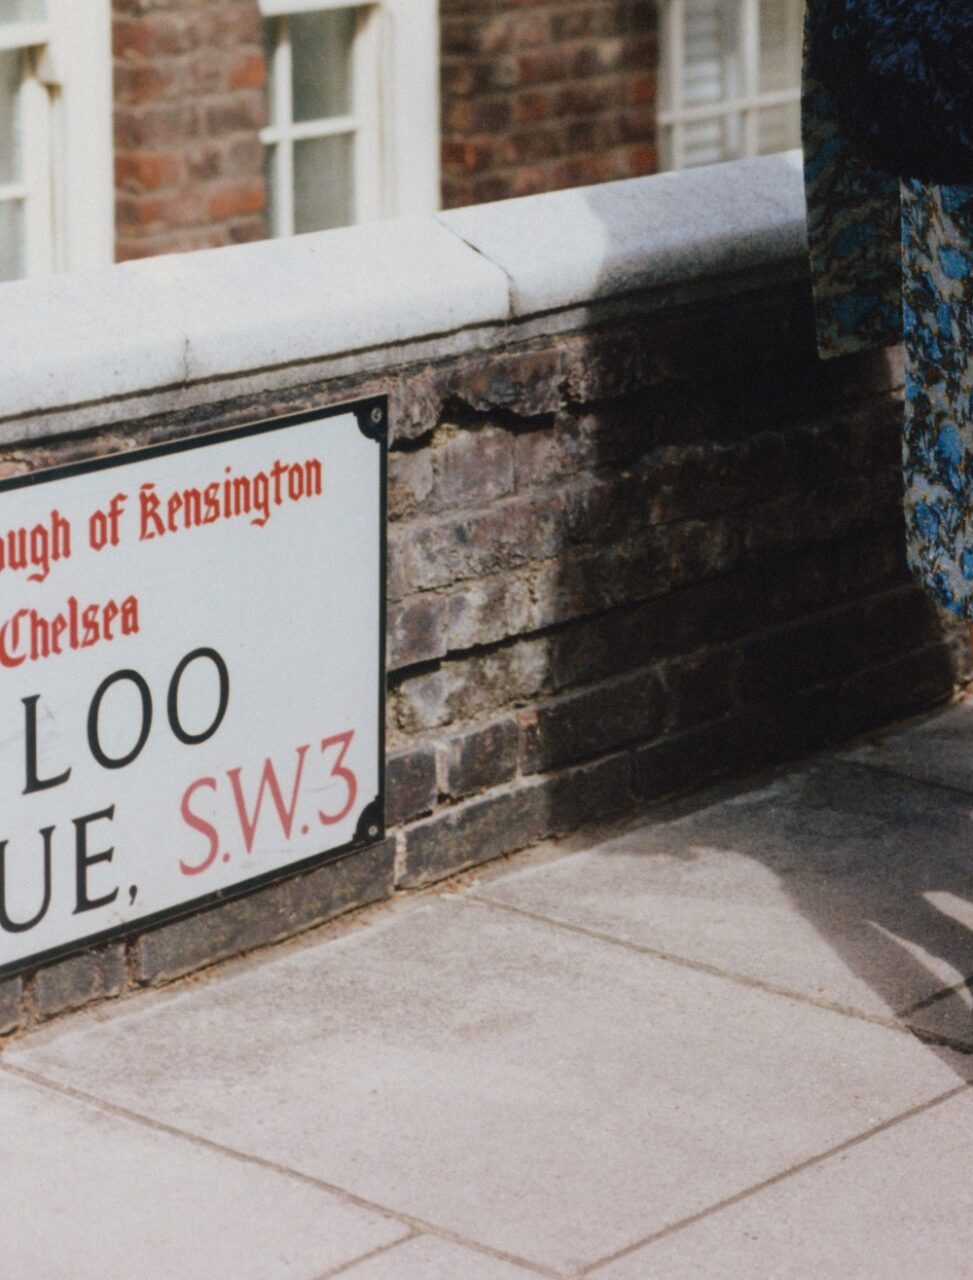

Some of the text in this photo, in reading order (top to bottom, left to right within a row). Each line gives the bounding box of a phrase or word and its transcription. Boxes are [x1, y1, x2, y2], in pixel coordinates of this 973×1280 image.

[0, 457, 324, 583] ugh of Kensington
[0, 594, 140, 669] Chelsea
[21, 646, 231, 795] LOO
[0, 729, 358, 933] UE, S.W.3
